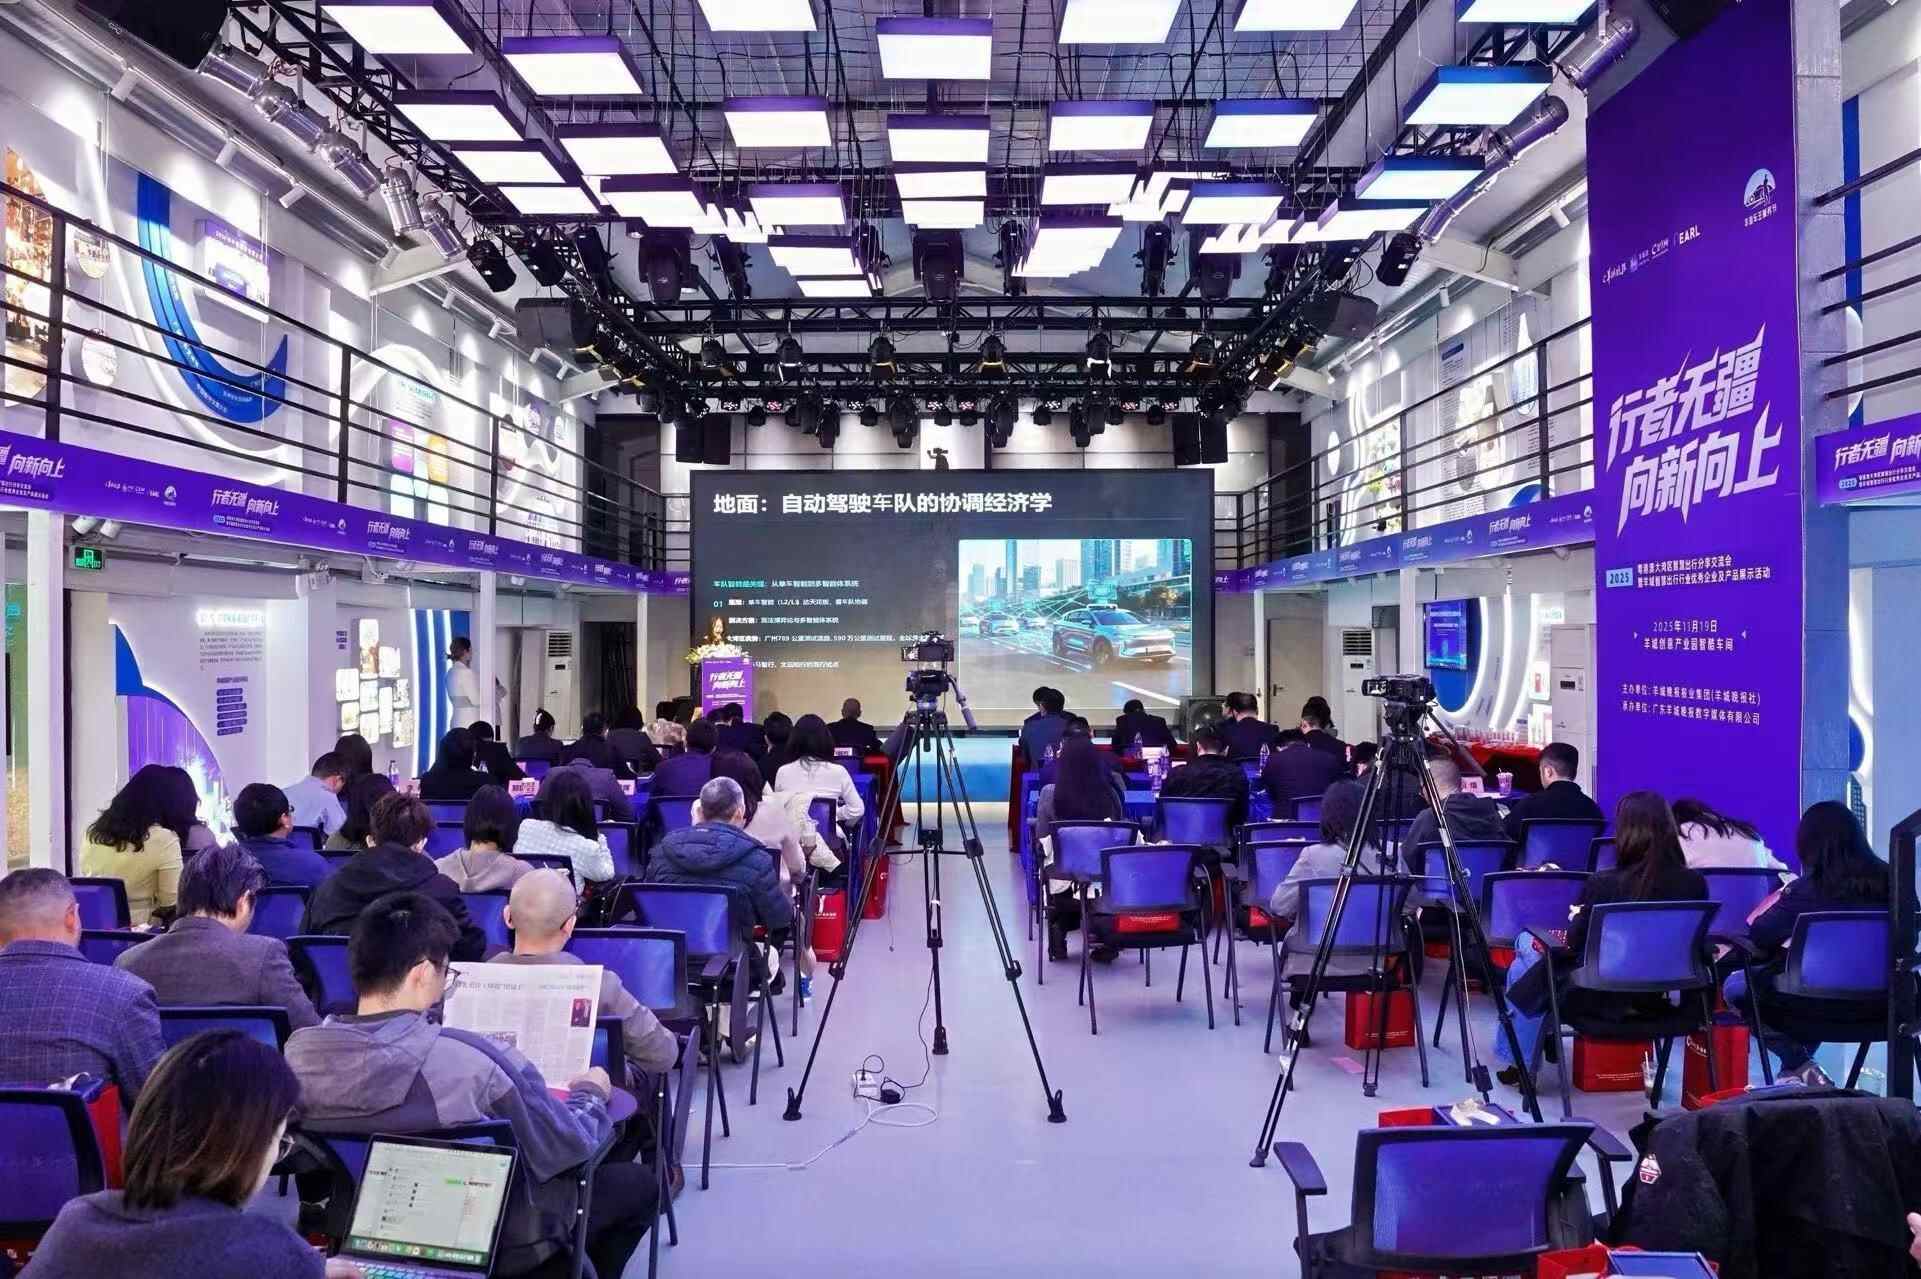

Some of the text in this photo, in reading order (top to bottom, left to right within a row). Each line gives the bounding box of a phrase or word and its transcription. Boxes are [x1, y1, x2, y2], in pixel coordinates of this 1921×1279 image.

[1606, 320, 1767, 472] 行者无疆
[8, 454, 66, 479] 向新向上
[1833, 432, 1891, 472] 行者无疆
[1616, 400, 1784, 538] 向新向上
[210, 488, 280, 517] 行者无疆 向新向上
[713, 492, 1053, 514] 地面：自动驾驶车队的协调经济学
[1609, 572, 1630, 585] 2025
